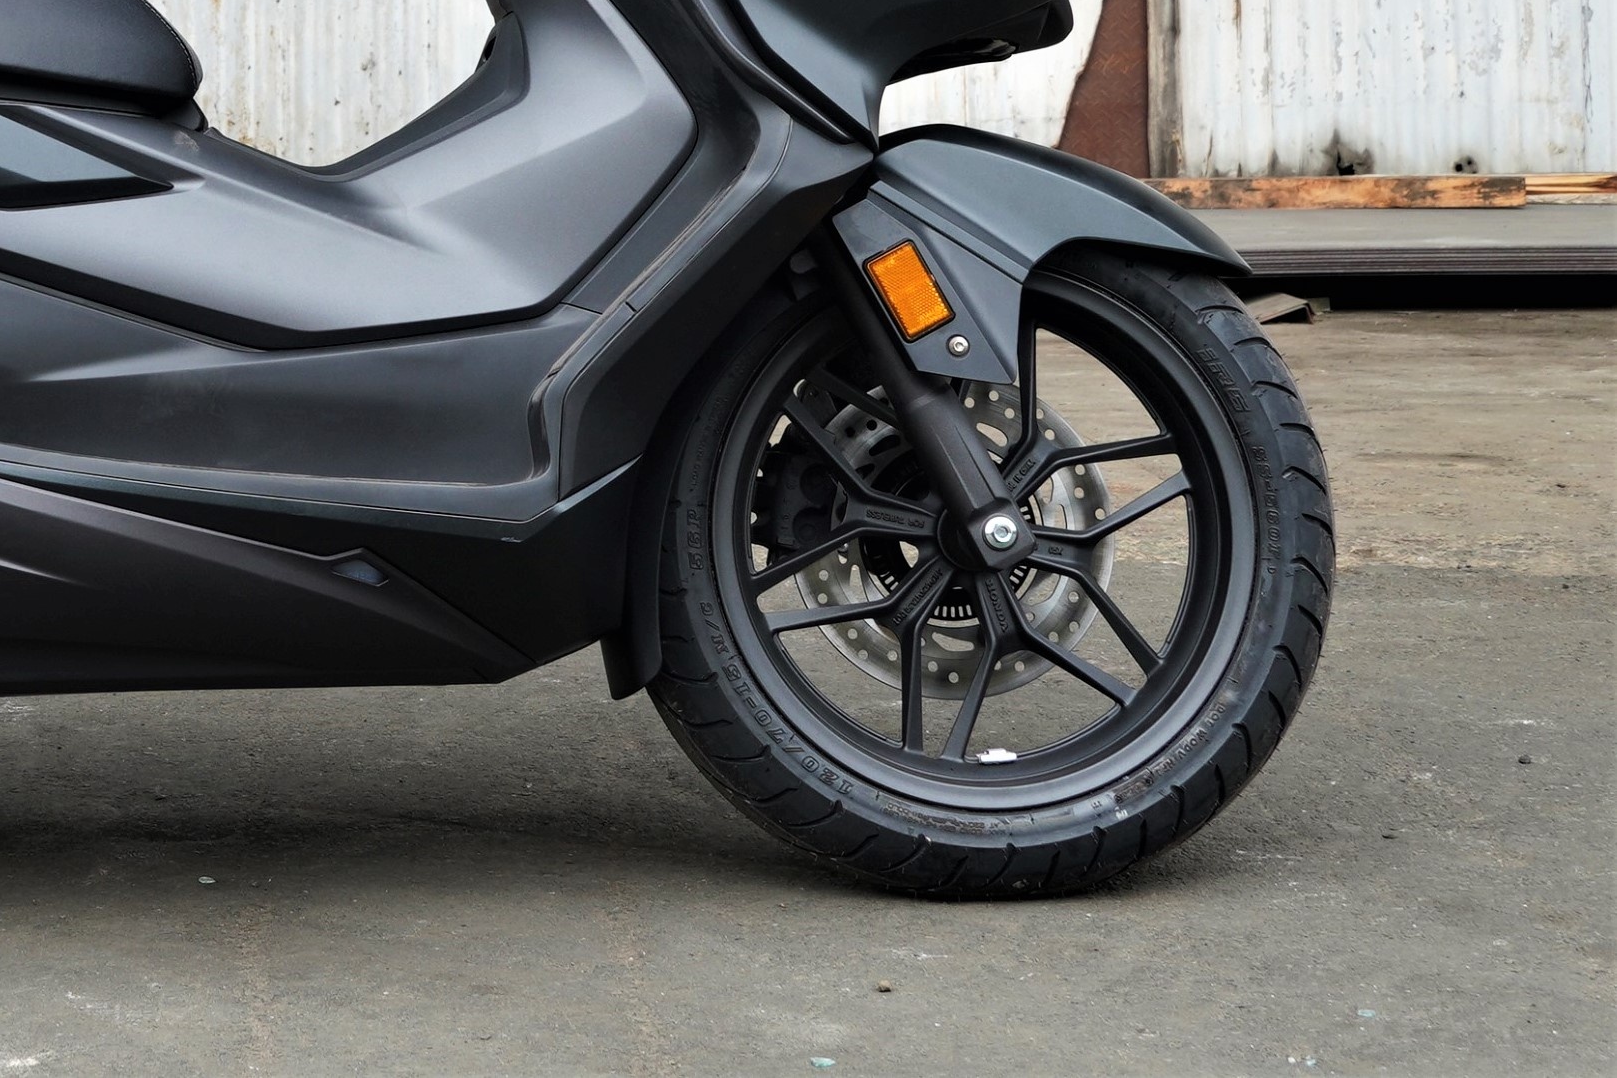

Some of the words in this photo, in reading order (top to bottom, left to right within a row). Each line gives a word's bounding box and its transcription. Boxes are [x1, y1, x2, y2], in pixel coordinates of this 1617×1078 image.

[700, 601, 729, 656] M/C
[985, 578, 1009, 632] HONDA
[721, 663, 854, 795] 120/70-15
